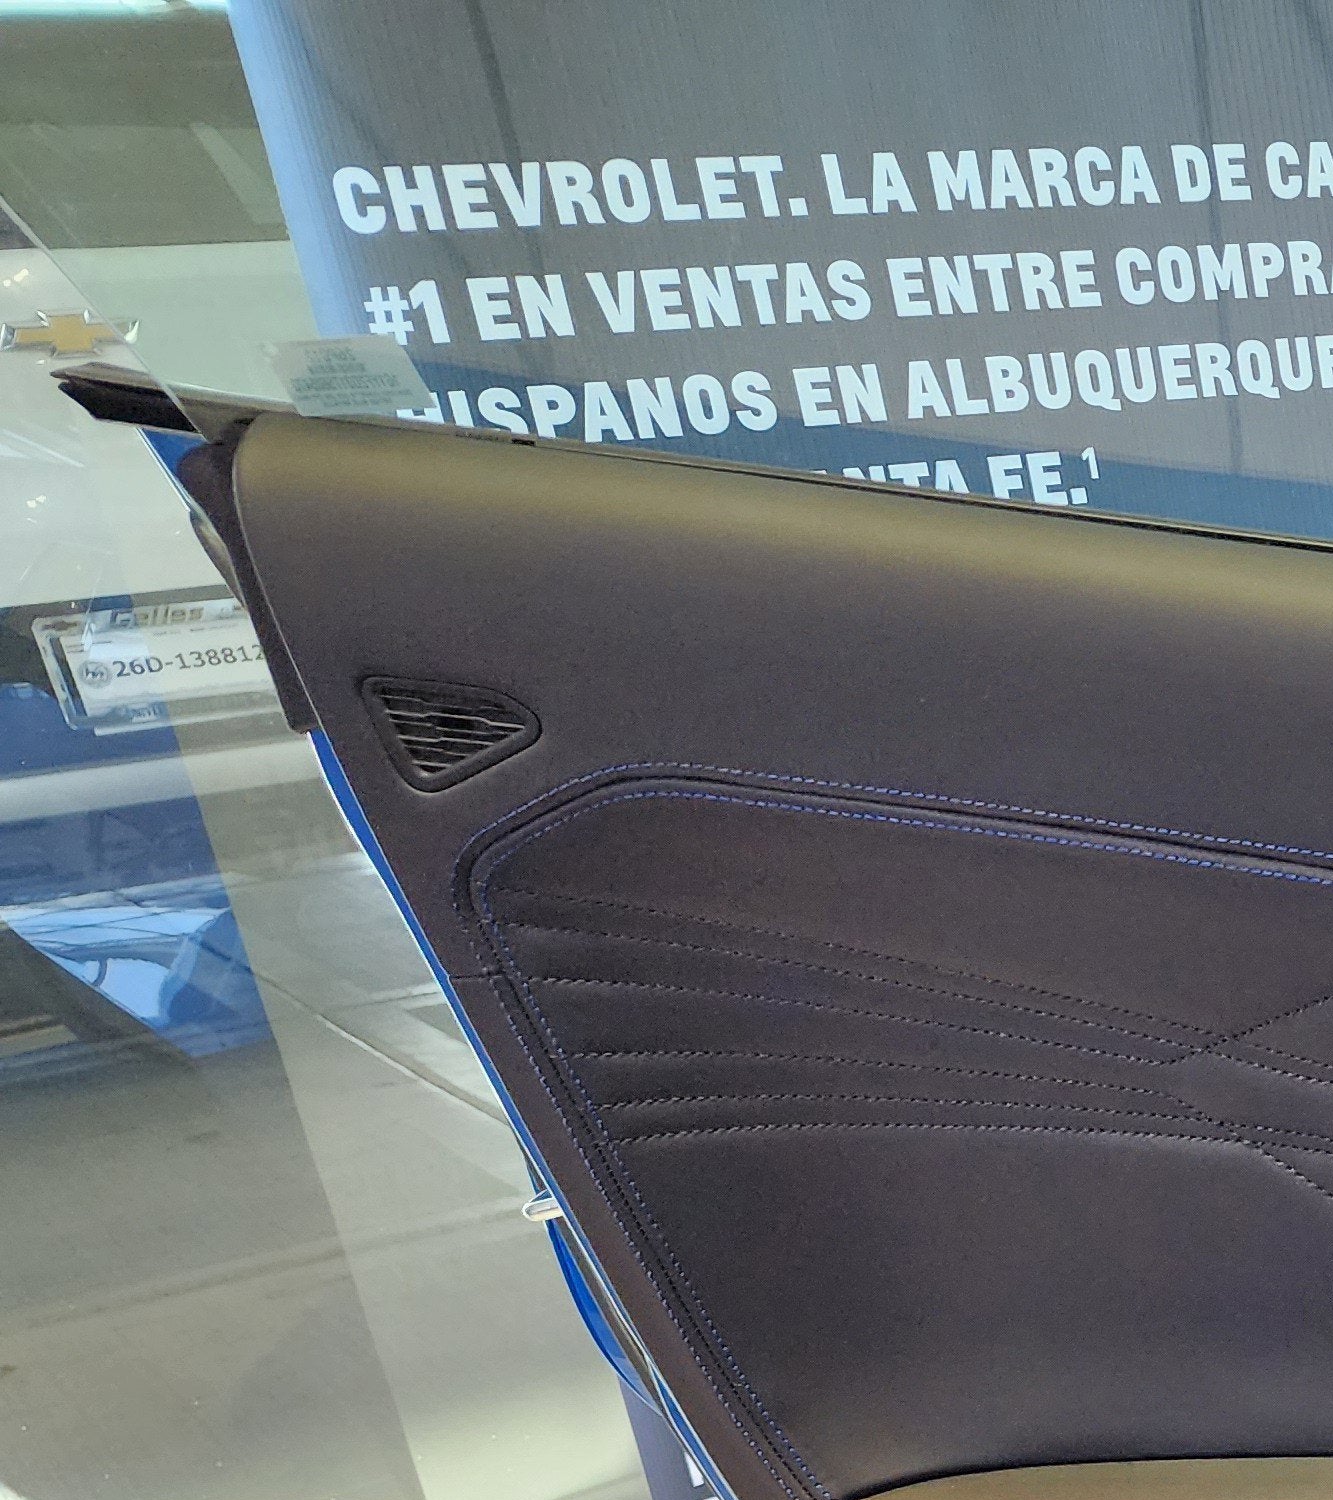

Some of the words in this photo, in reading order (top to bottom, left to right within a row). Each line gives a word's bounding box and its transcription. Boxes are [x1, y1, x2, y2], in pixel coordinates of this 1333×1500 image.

[333, 154, 808, 235] CHEVROLET.
[821, 151, 917, 215] LA
[927, 145, 1161, 211] MARCA
[1171, 143, 1252, 202] DE
[364, 278, 450, 346] #1
[466, 274, 575, 341] EN
[585, 260, 872, 334] VENTAS
[886, 250, 1102, 318] ENTRE
[793, 363, 887, 427] EN
